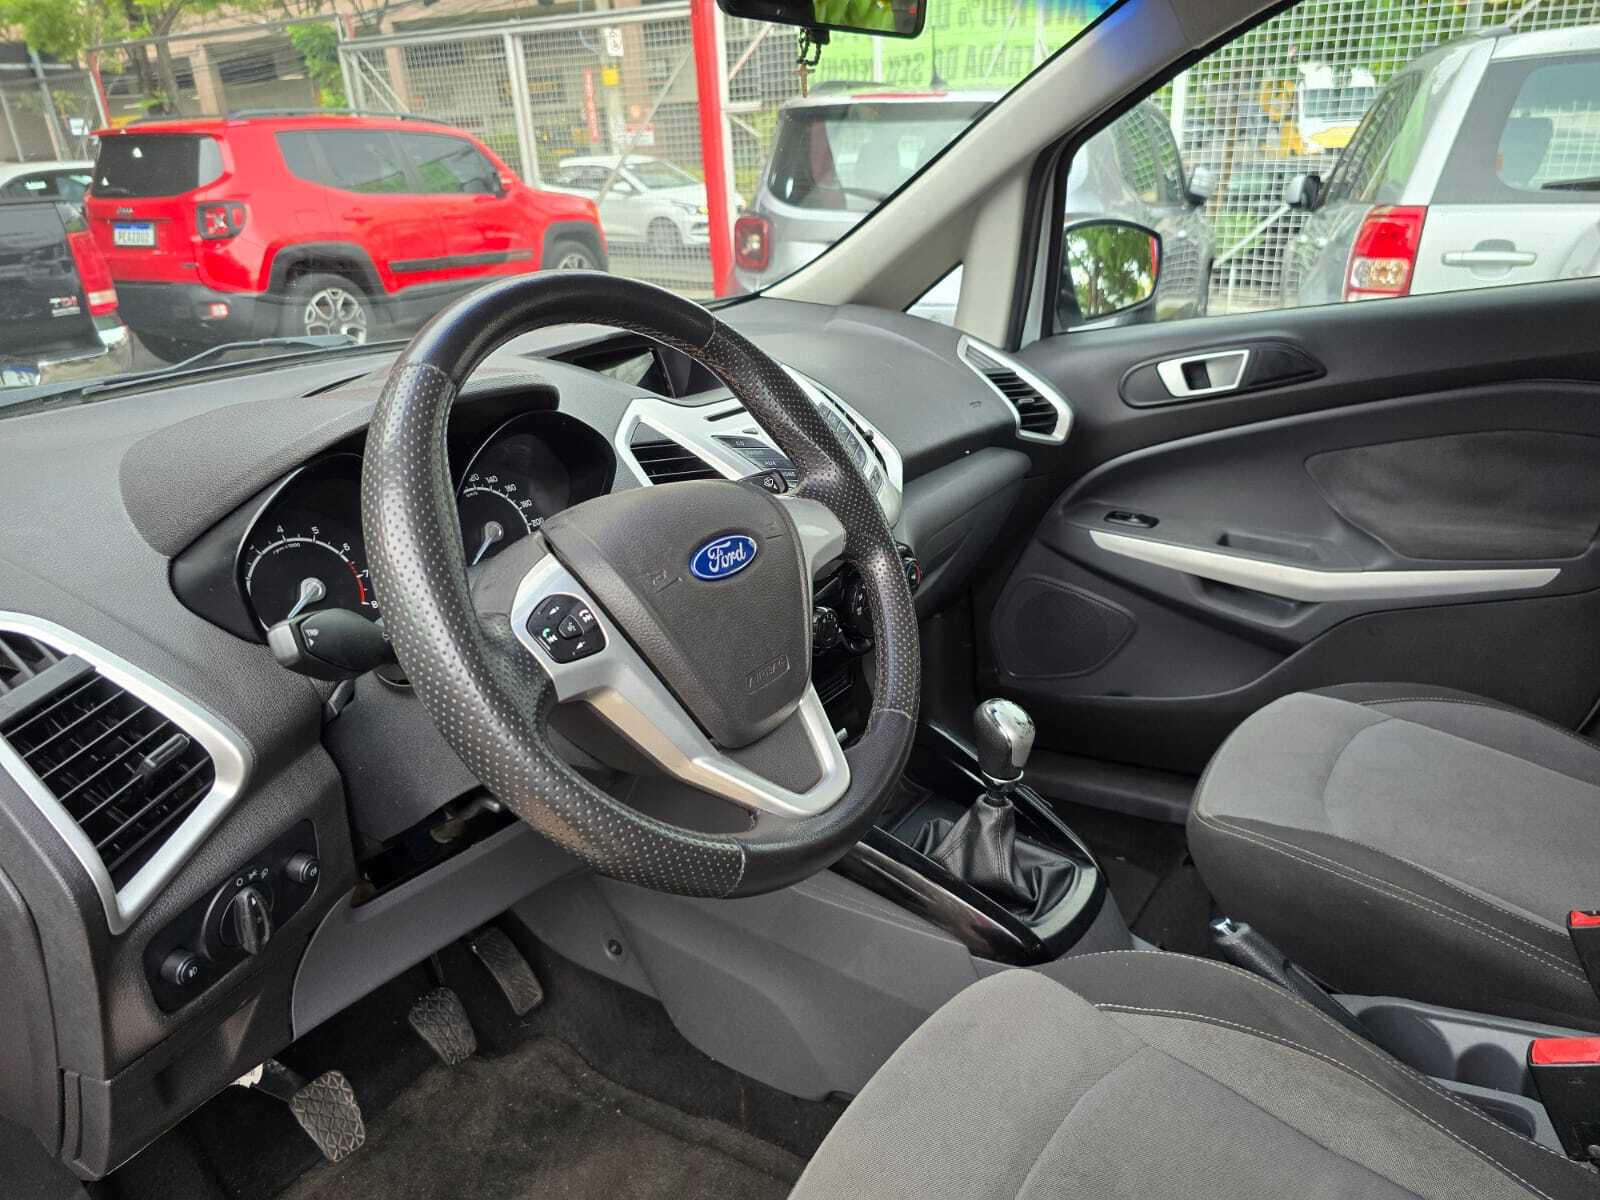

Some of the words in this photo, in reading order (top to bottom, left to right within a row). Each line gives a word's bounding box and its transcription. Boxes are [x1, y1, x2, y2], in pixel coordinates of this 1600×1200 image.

[276, 524, 284, 533] 4
[311, 526, 320, 535] 5
[342, 542, 351, 551] 6
[707, 541, 747, 573] Ford
[370, 600, 378, 609] 8
